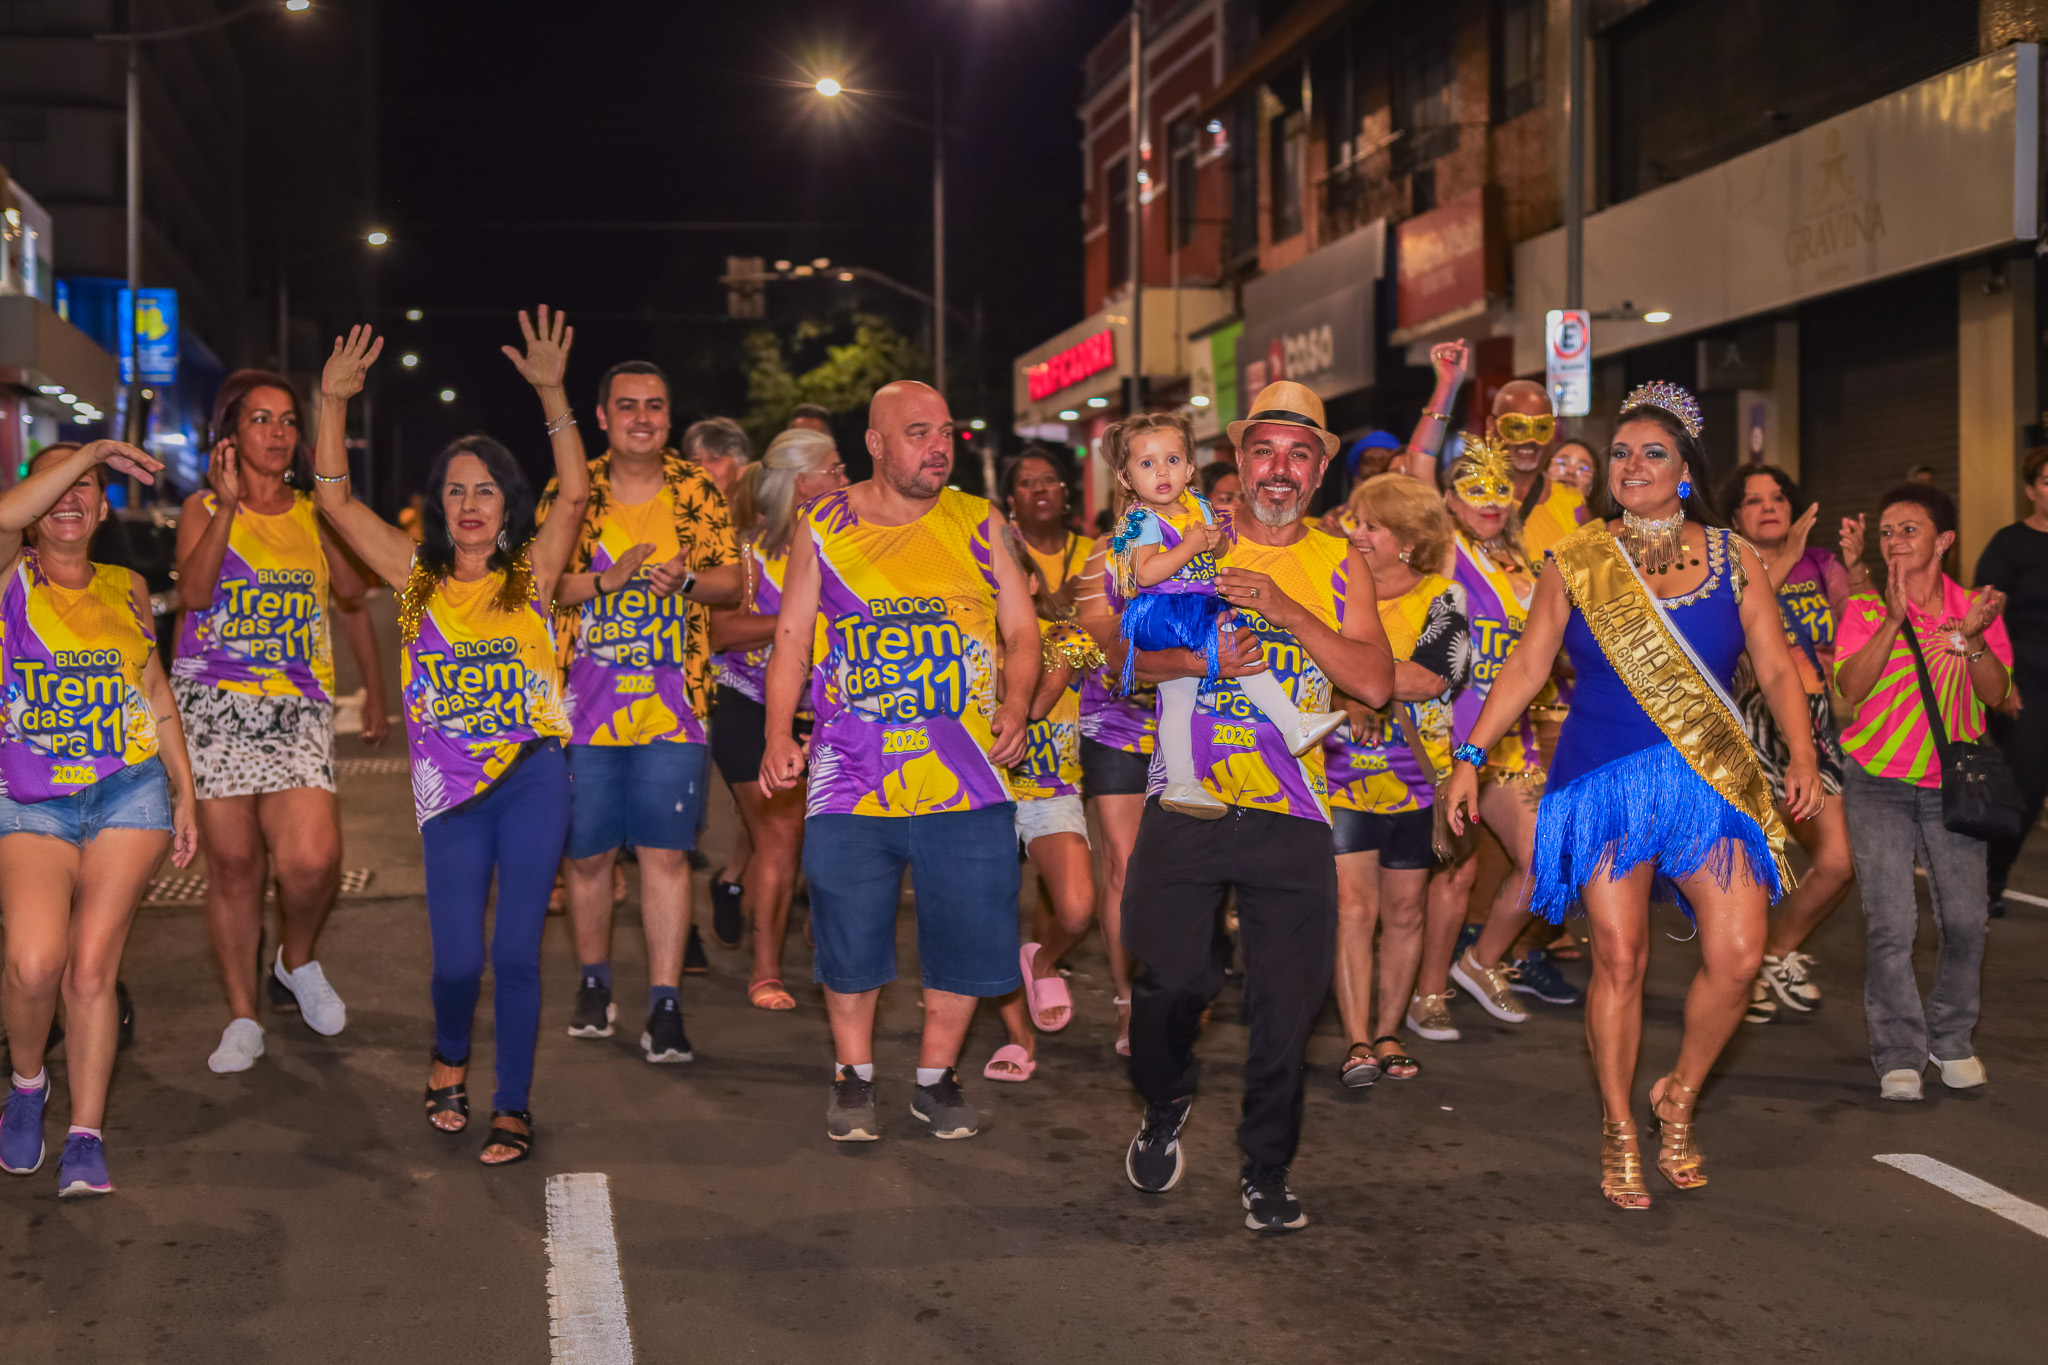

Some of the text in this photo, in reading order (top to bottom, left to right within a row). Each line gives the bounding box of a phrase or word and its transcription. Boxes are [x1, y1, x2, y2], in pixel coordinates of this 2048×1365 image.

[1784, 203, 1886, 267] GRAVINA
[257, 570, 314, 585] BLOCO
[221, 578, 314, 619] Trem
[870, 598, 945, 617] BLOCO
[222, 617, 310, 660] das 11
[835, 614, 961, 661] Trem
[1801, 610, 1833, 641] 11
[250, 640, 281, 661] PG
[454, 638, 516, 658] BLOCO
[588, 617, 682, 663] das 11
[1593, 605, 1656, 699] PONTA GROSSA
[1604, 591, 1671, 677] RAINHA
[1656, 674, 1687, 704] DO
[55, 650, 120, 667] BLOCO
[615, 644, 648, 666] PG
[13, 662, 123, 707] Trem
[417, 653, 524, 694] Trem
[616, 675, 655, 693] 2026
[847, 658, 959, 713] das 11
[433, 691, 524, 726] das 11
[879, 693, 917, 719] PG
[1215, 691, 1250, 717] PG
[22, 705, 121, 752] das 11
[463, 714, 497, 734] PG
[1212, 723, 1255, 748] 2026
[52, 733, 86, 756] PG
[882, 727, 929, 754] 2026
[51, 765, 97, 784] 2026
[1350, 753, 1388, 770] 2026
